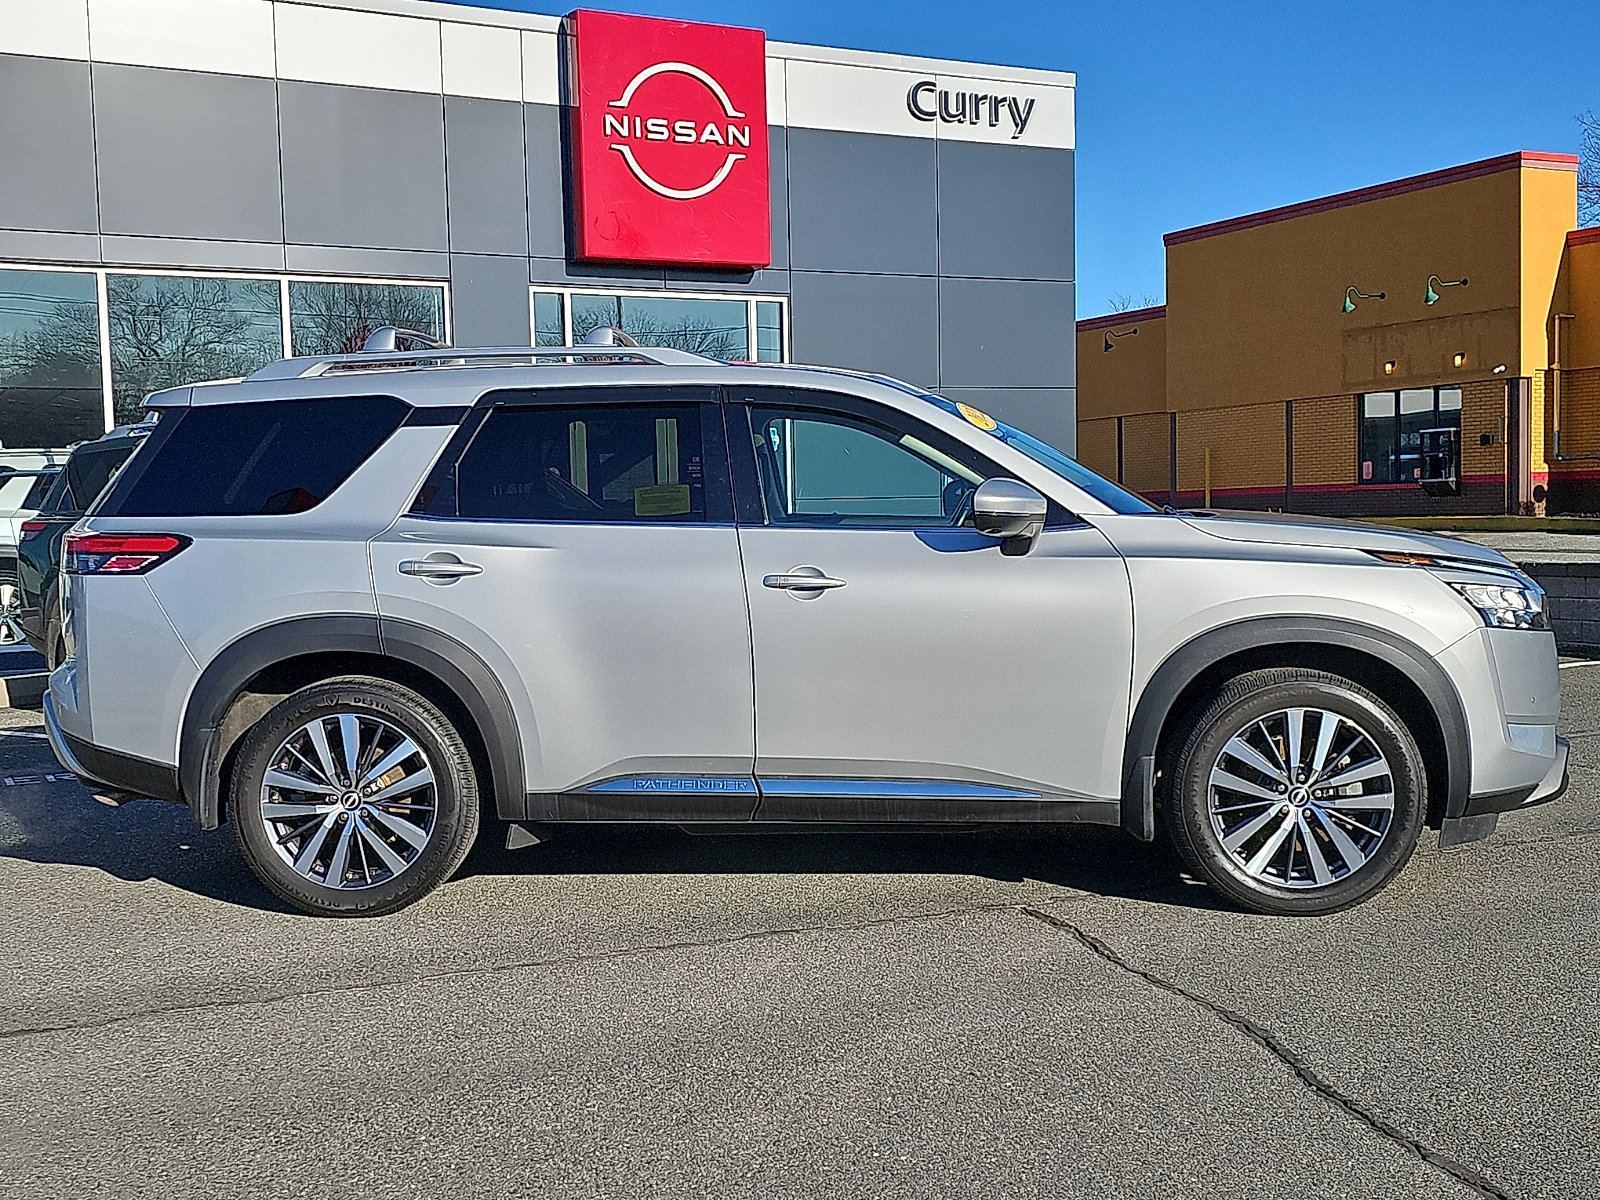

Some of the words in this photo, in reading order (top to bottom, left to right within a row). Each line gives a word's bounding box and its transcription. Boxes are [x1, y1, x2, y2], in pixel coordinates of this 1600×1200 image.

[907, 80, 1036, 139] Curry
[604, 113, 750, 148] NISSAN
[632, 779, 748, 791] PATHFINDER
